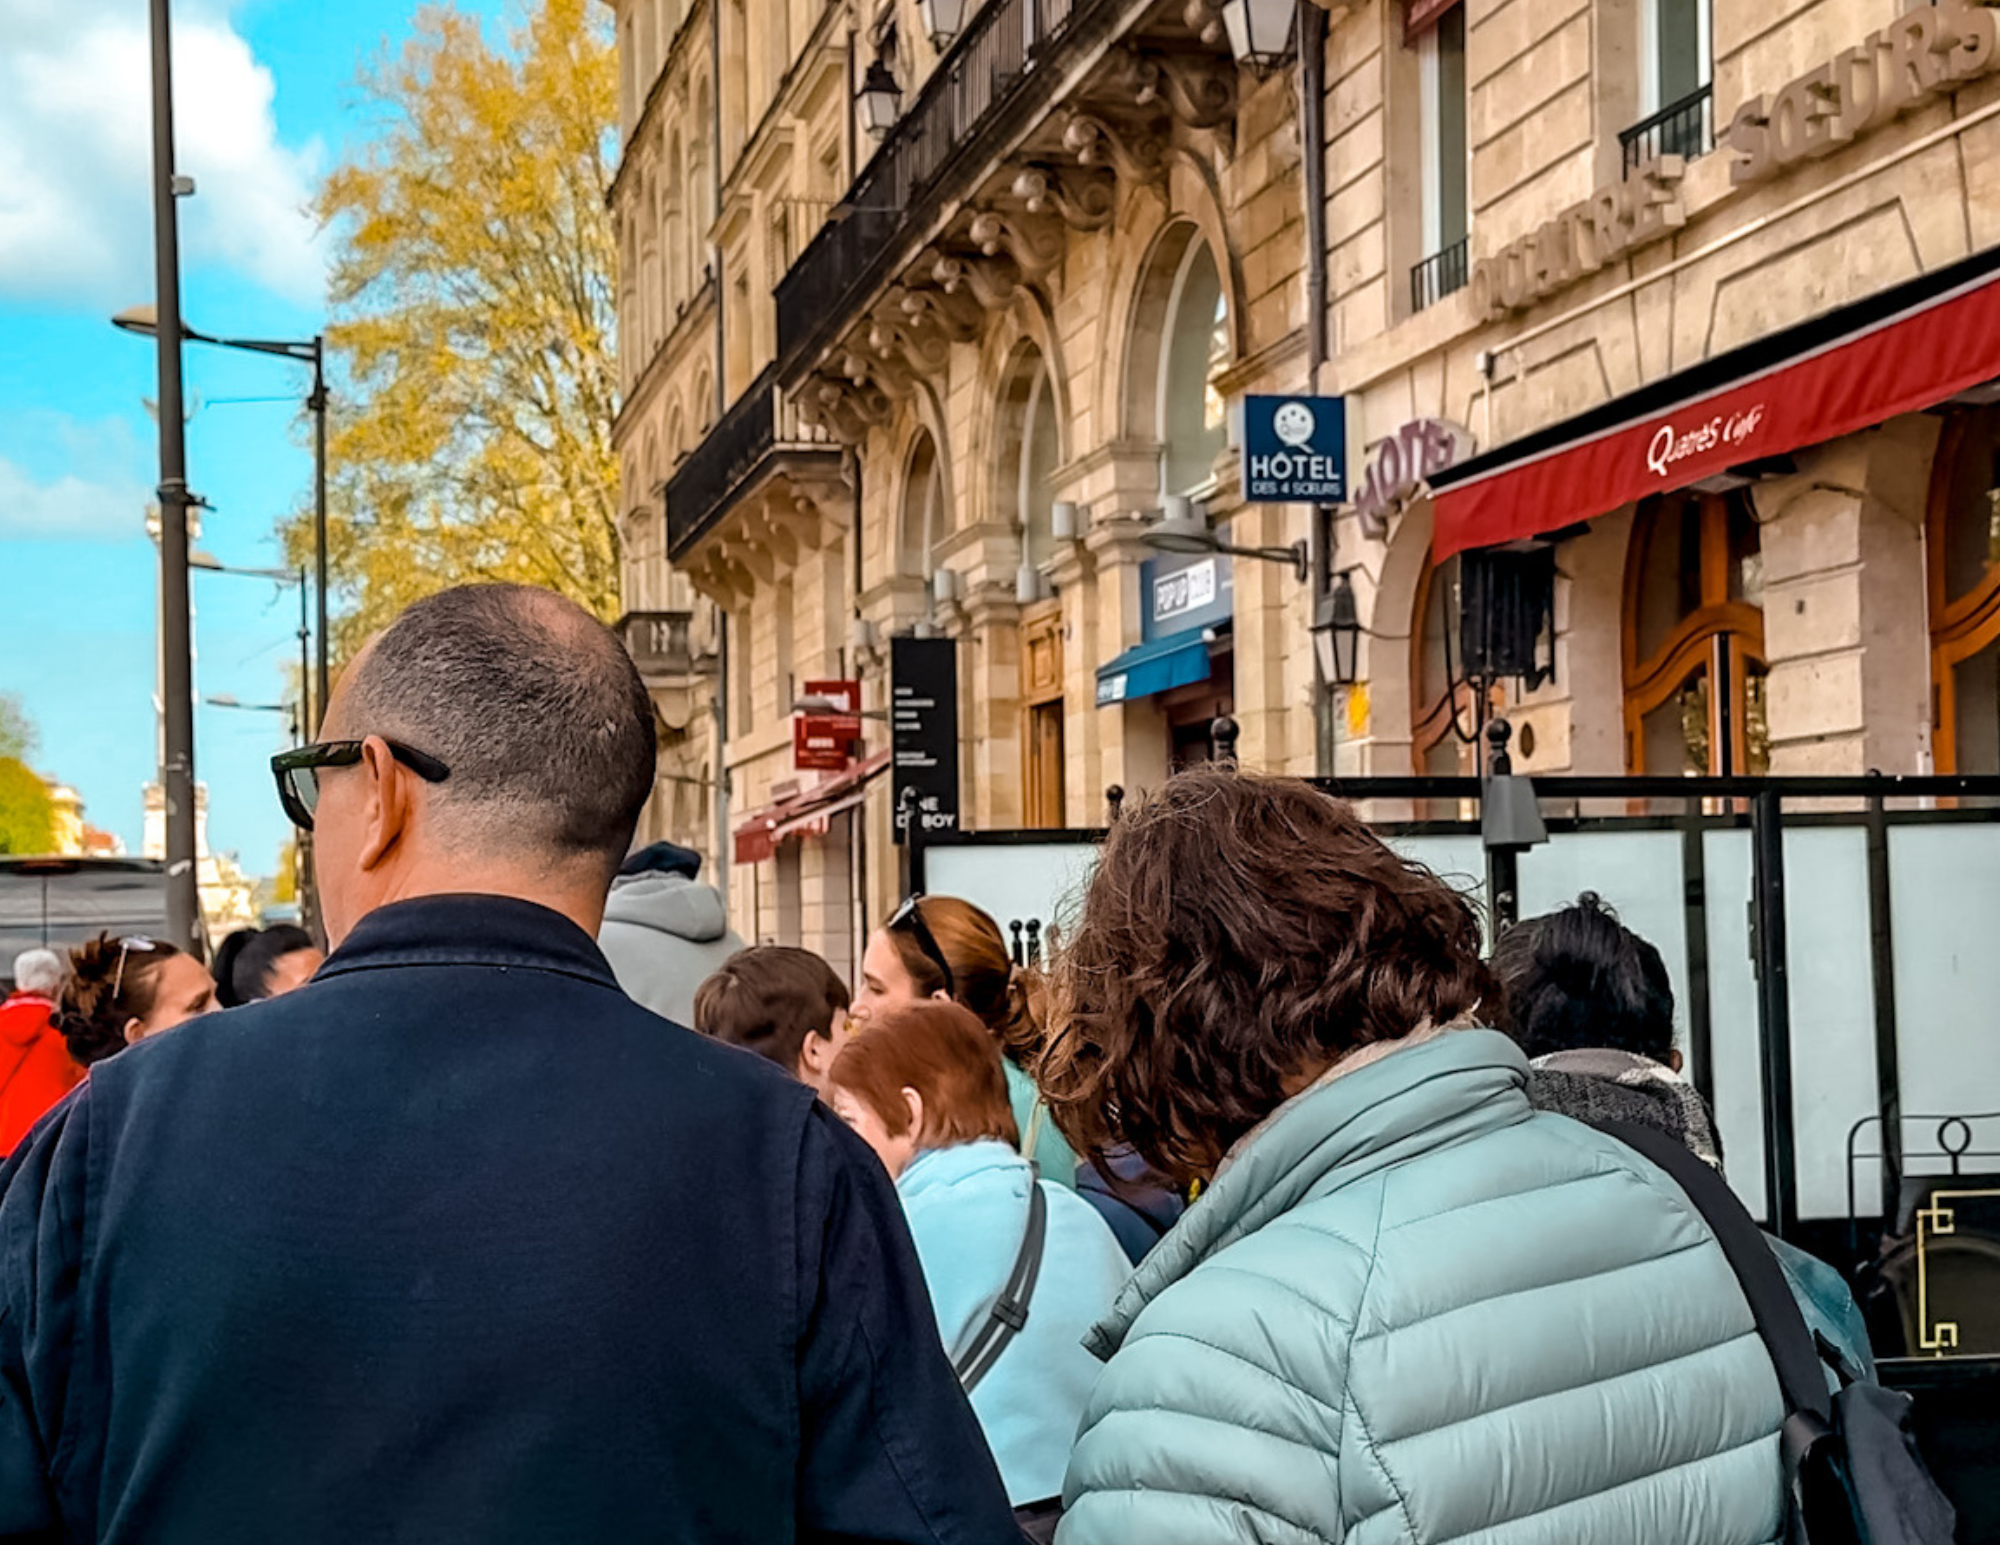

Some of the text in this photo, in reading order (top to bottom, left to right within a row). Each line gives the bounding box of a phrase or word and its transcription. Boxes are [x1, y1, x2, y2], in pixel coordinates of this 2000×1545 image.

[1251, 452, 1340, 480] HÔTEL
[1252, 481, 1277, 496] DES
[1280, 481, 1290, 495] 4
[921, 812, 955, 829] BOY
